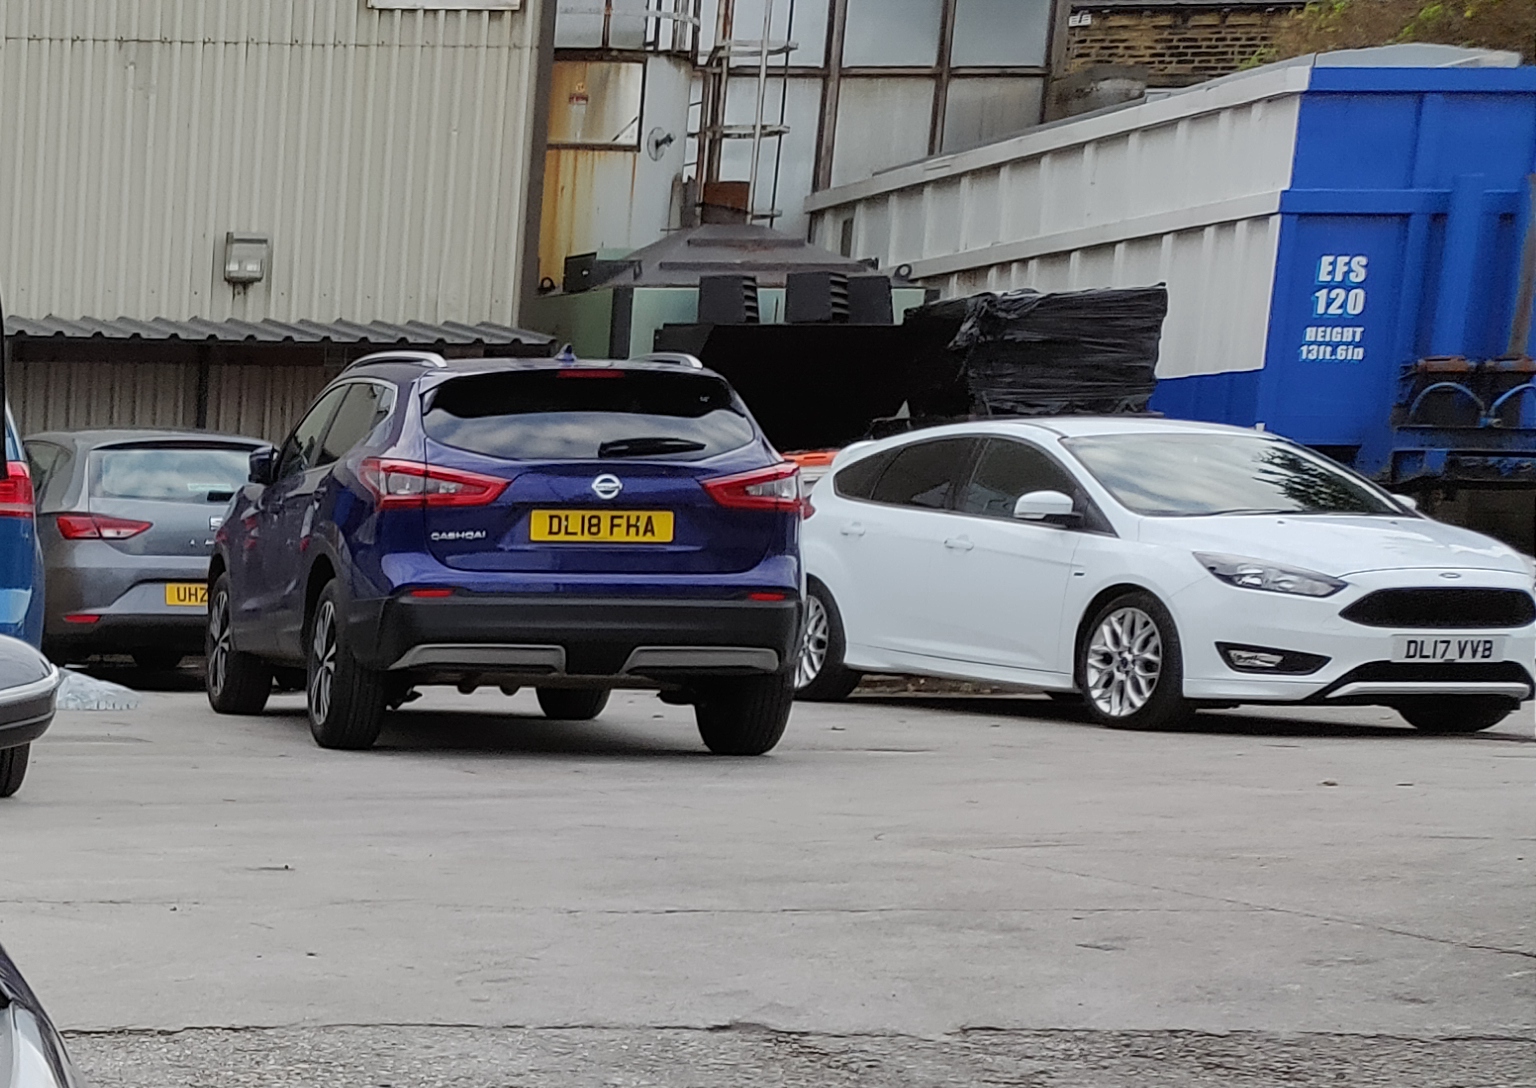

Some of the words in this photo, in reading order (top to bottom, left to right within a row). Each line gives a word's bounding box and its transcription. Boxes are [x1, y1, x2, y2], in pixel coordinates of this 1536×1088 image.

[1317, 255, 1368, 283] EFS
[1313, 288, 1365, 316] 120
[1304, 326, 1365, 342] HEIGHT
[547, 514, 601, 537] DL18
[609, 514, 656, 537] FHA
[1404, 640, 1451, 659] DL17
[1457, 640, 1493, 659] VVB
